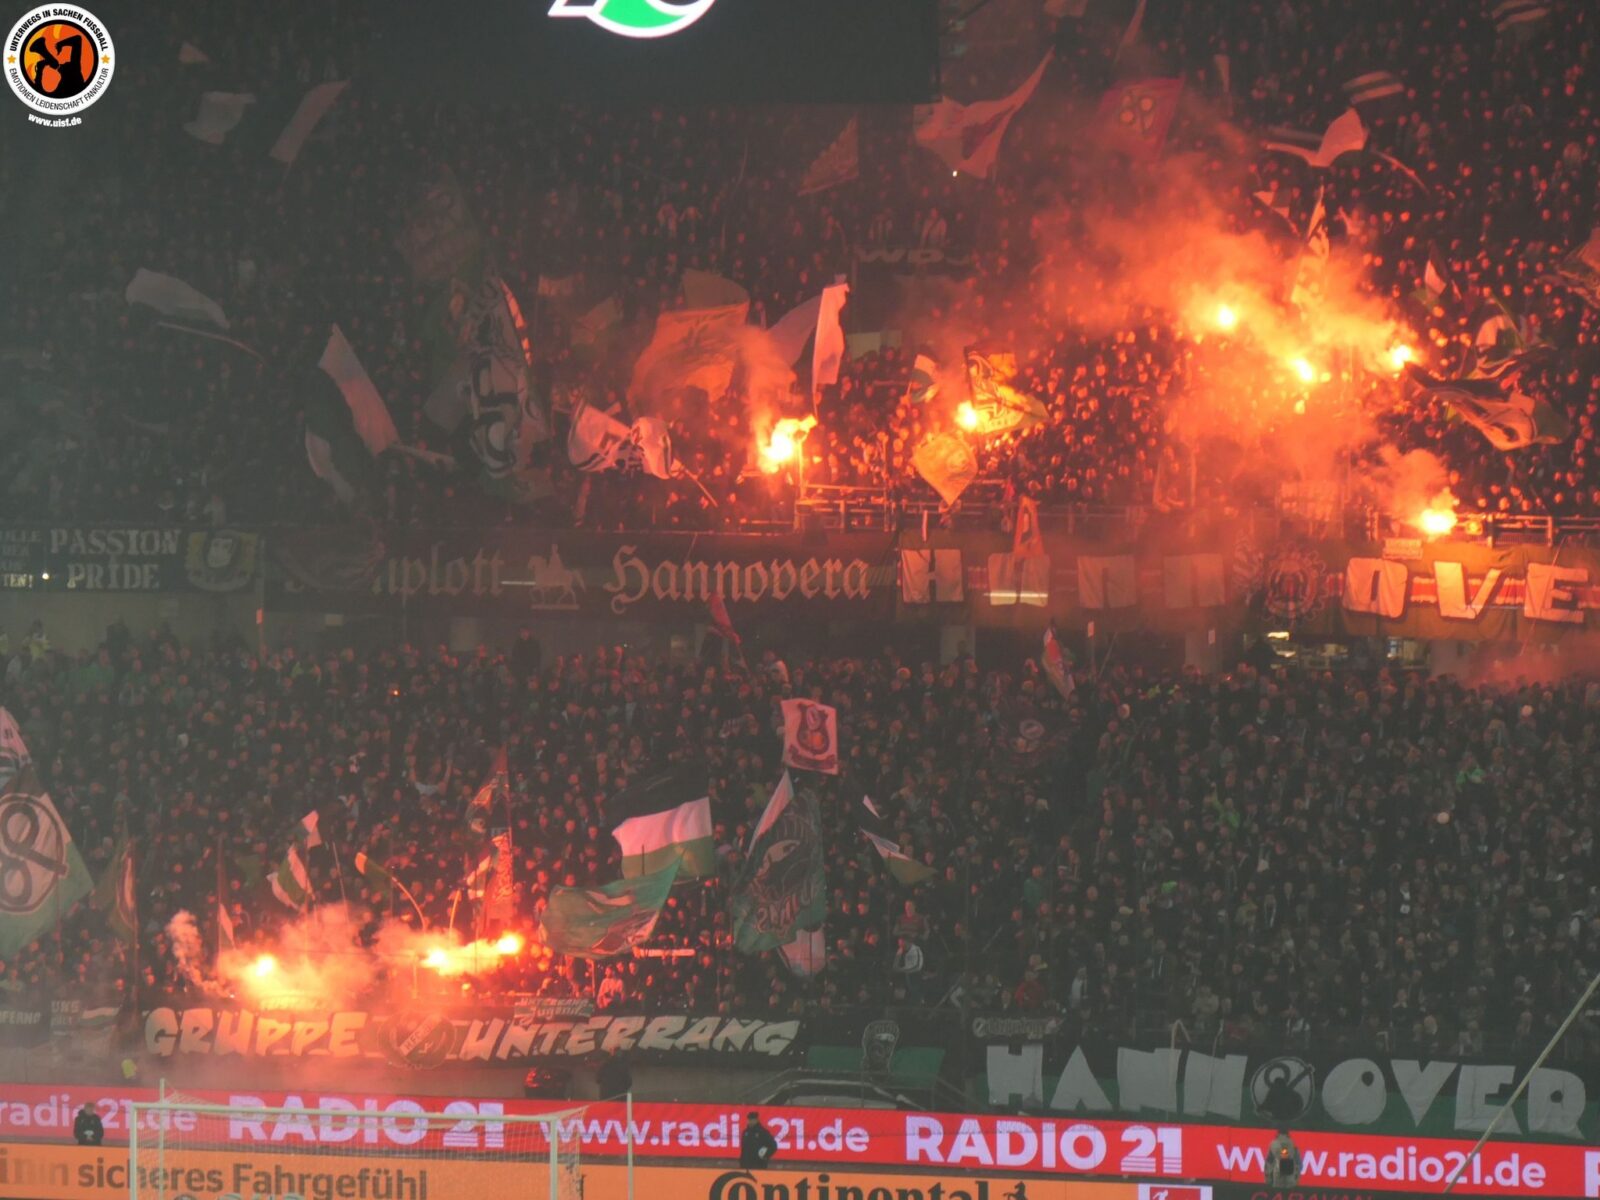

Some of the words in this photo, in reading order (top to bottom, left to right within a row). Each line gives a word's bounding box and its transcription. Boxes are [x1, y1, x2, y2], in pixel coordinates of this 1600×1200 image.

[50, 528, 182, 555] PASSION
[66, 562, 160, 590] PRIDE
[603, 544, 872, 615] Hannovera
[144, 1006, 368, 1058] GRUPPE
[457, 1014, 801, 1061] UNTERRANG
[228, 1095, 429, 1146] RADIO
[442, 1100, 505, 1148] 21
[540, 1112, 870, 1153] www.radi21.de
[905, 1115, 1108, 1171] RADIO
[1119, 1125, 1183, 1174] 21
[78, 1156, 224, 1193] sicheres
[232, 1163, 428, 1200] Fahrgefühl
